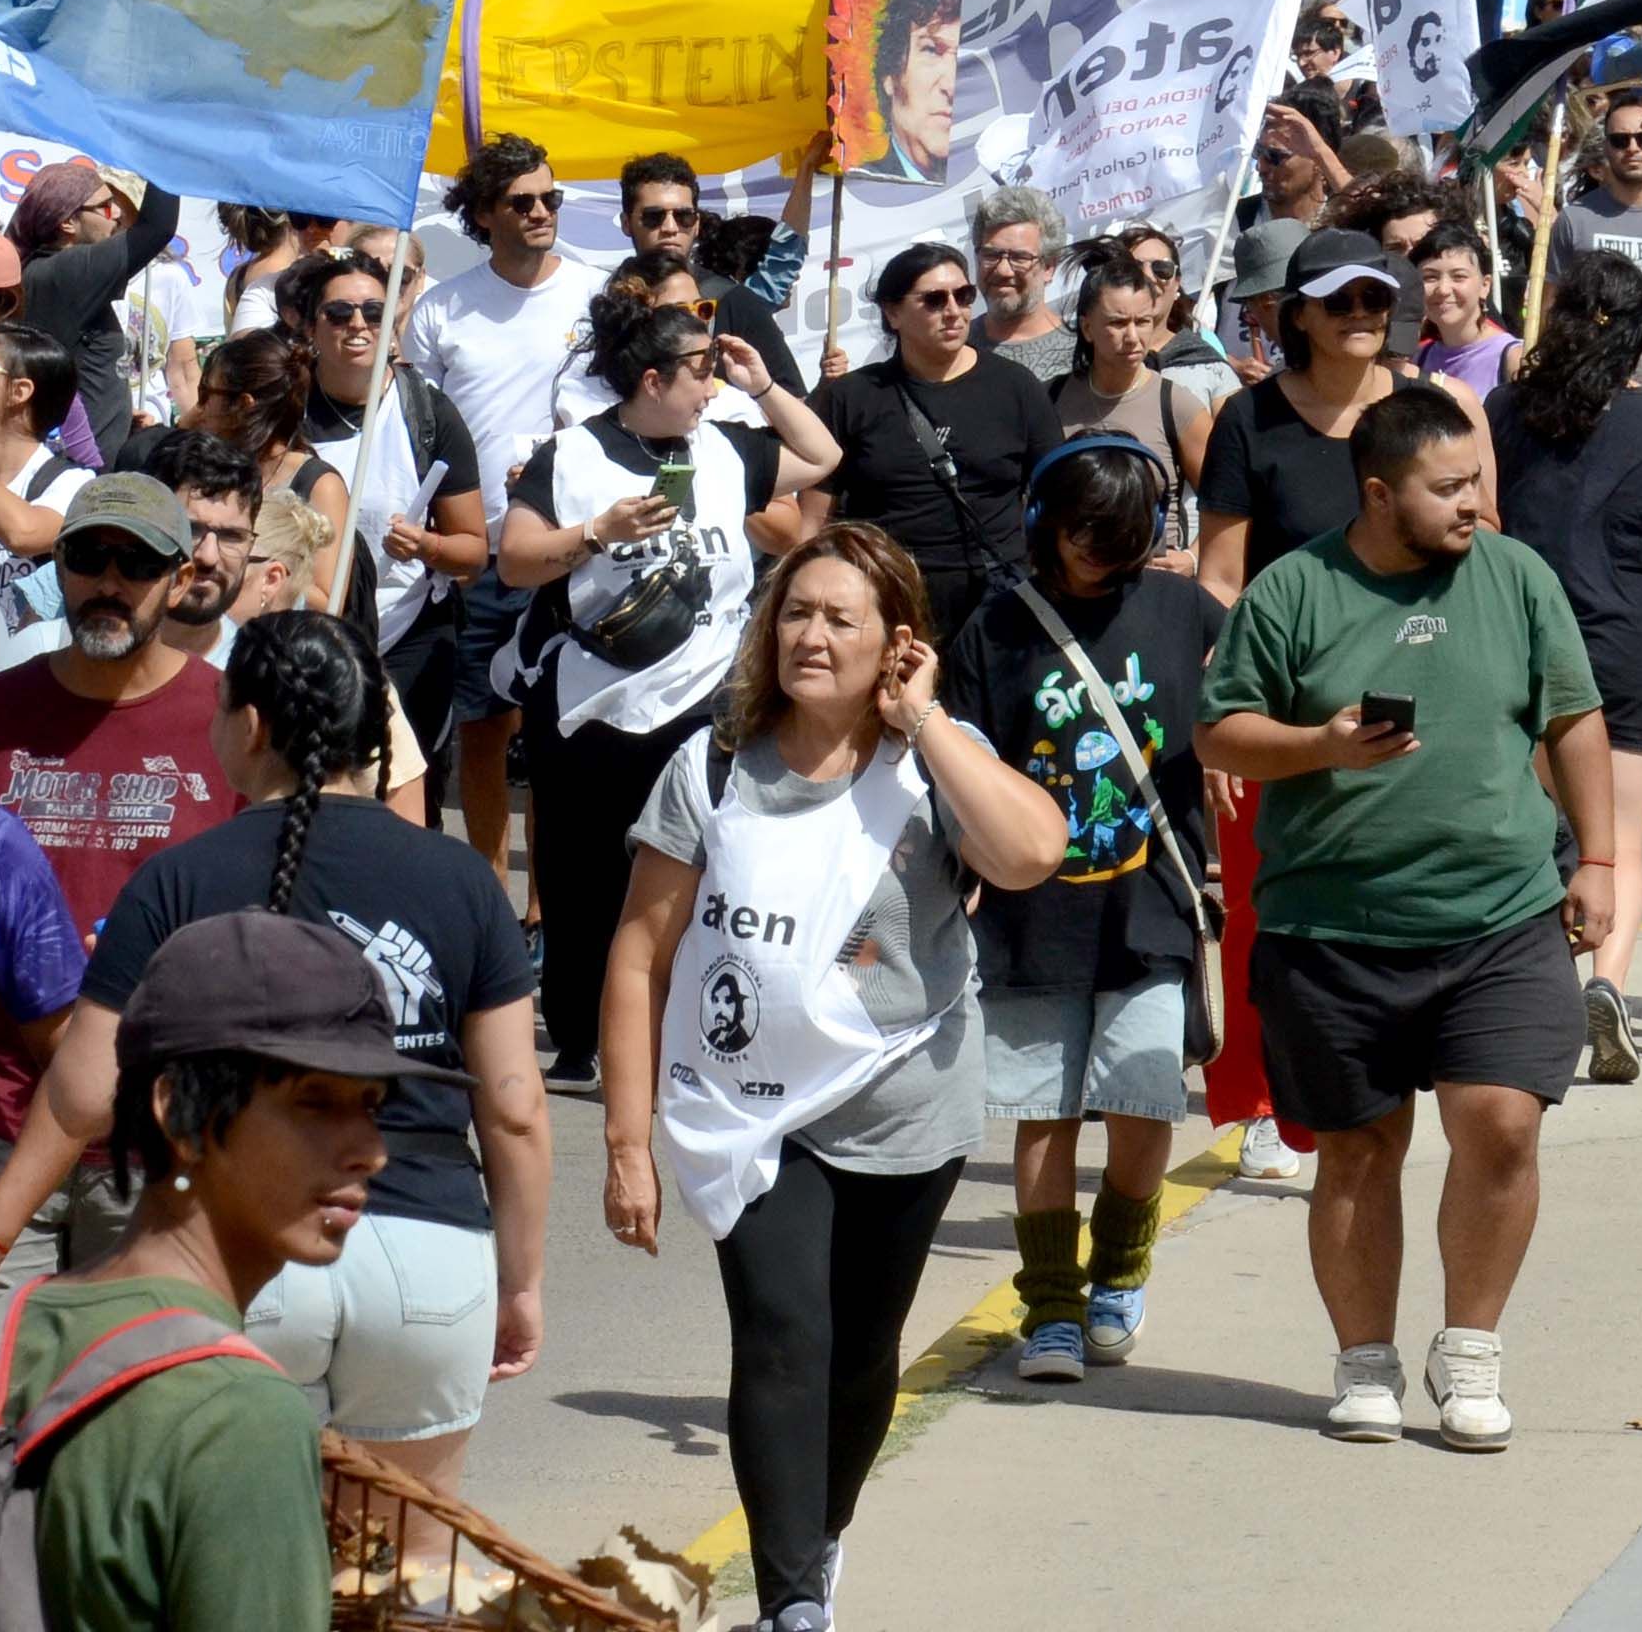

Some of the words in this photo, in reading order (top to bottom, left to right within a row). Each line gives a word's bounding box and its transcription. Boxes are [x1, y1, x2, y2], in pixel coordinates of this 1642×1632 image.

[493, 24, 815, 107] EPSTEIN
[1035, 652, 1155, 729] árol
[0, 768, 102, 805] MOTOR
[108, 773, 178, 804] SHOP
